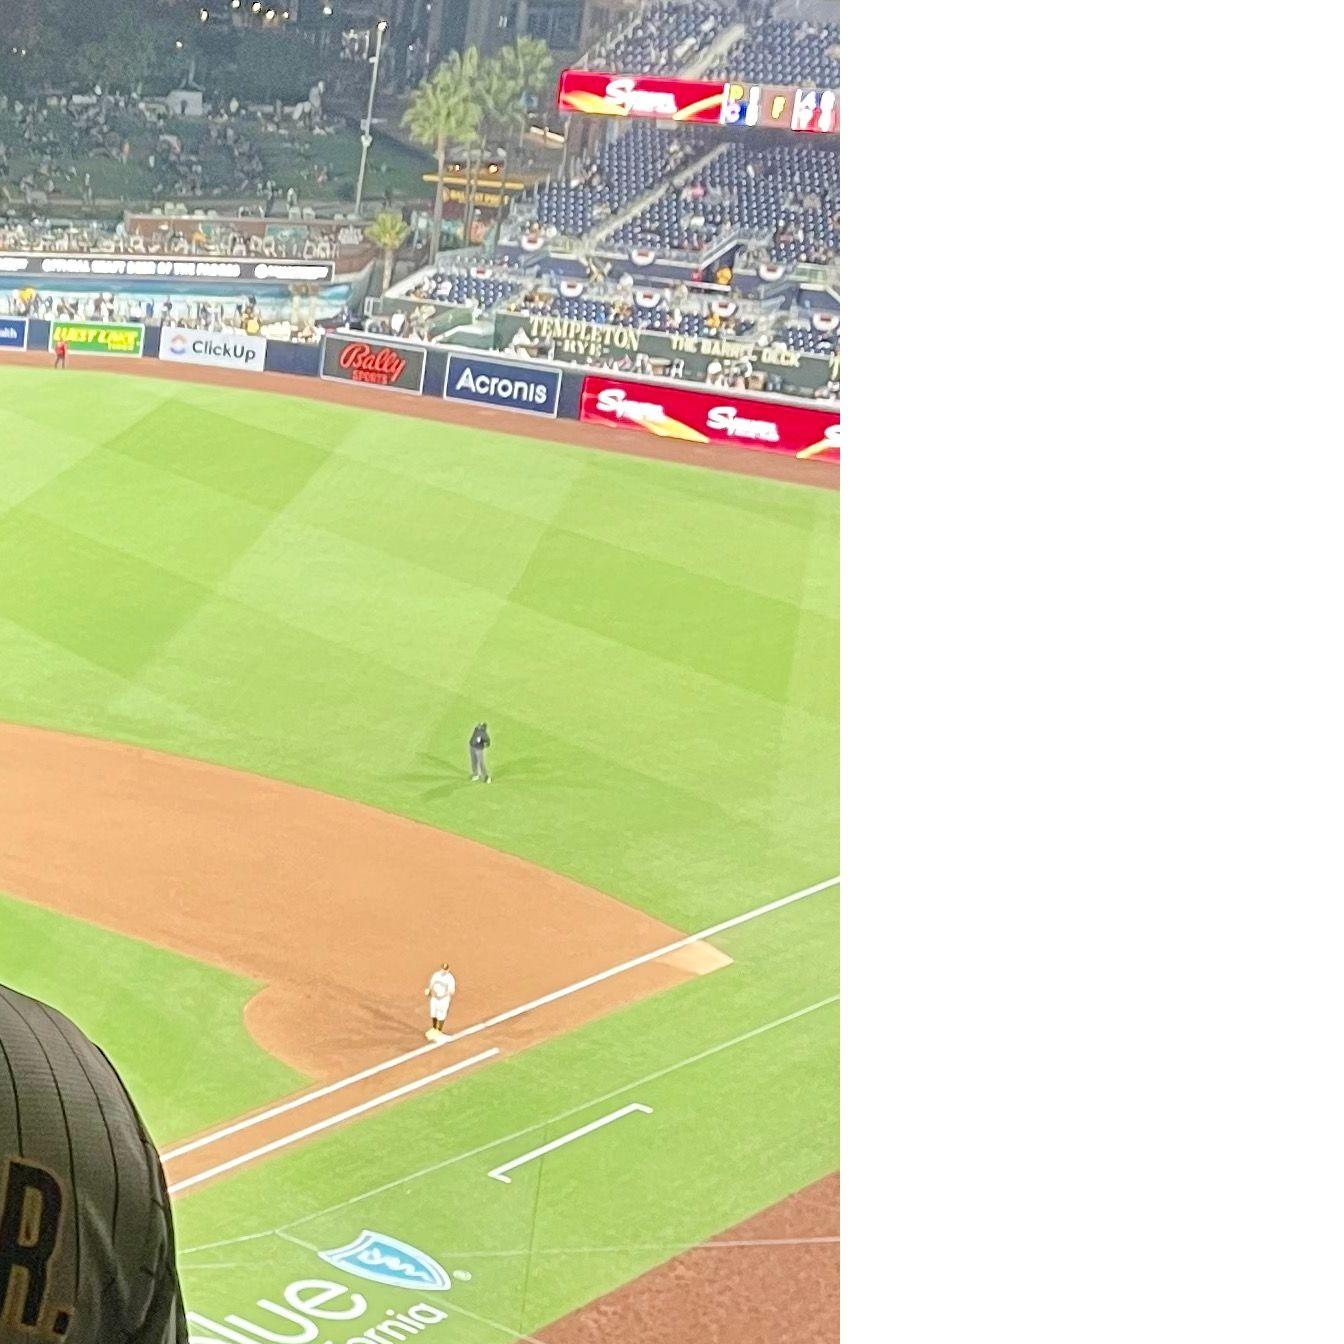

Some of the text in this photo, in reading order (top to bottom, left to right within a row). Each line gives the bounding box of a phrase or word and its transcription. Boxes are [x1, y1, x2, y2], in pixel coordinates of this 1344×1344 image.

[192, 340, 256, 363] ClickUp
[530, 316, 640, 351] TEMPLETON
[340, 342, 406, 382] Bally
[455, 367, 547, 404] Acronis
